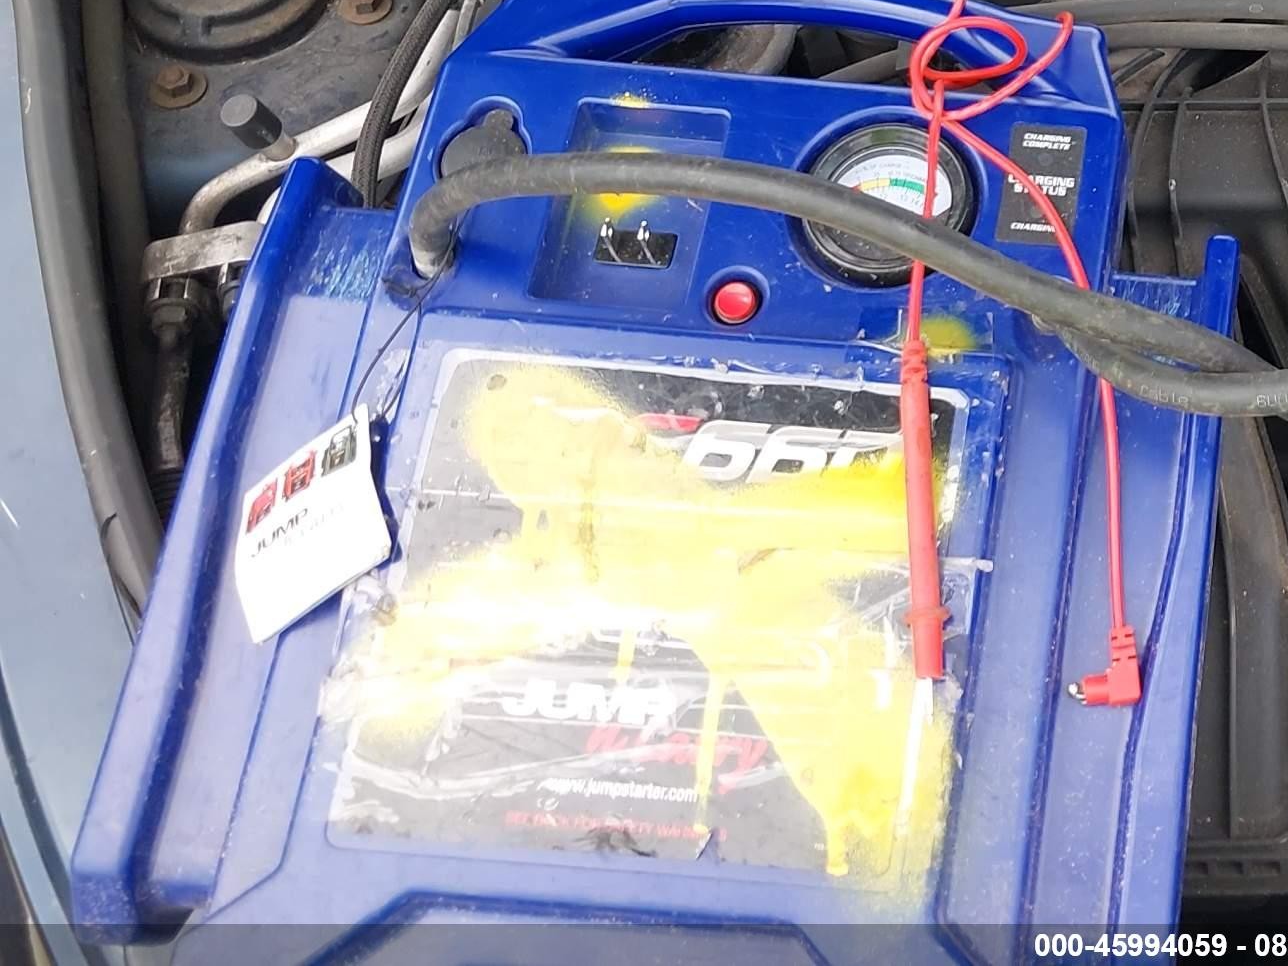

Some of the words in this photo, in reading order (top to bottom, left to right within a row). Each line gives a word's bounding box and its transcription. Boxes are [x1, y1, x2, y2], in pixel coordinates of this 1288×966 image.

[1024, 132, 1072, 143] CHARGING
[1022, 140, 1072, 150] COMPLETE
[1007, 173, 1075, 188] CARGING
[1014, 183, 1067, 196] STUS
[1010, 222, 1056, 233] CHARGIN
[251, 508, 309, 558] JUMP
[502, 679, 677, 727] JUMP
